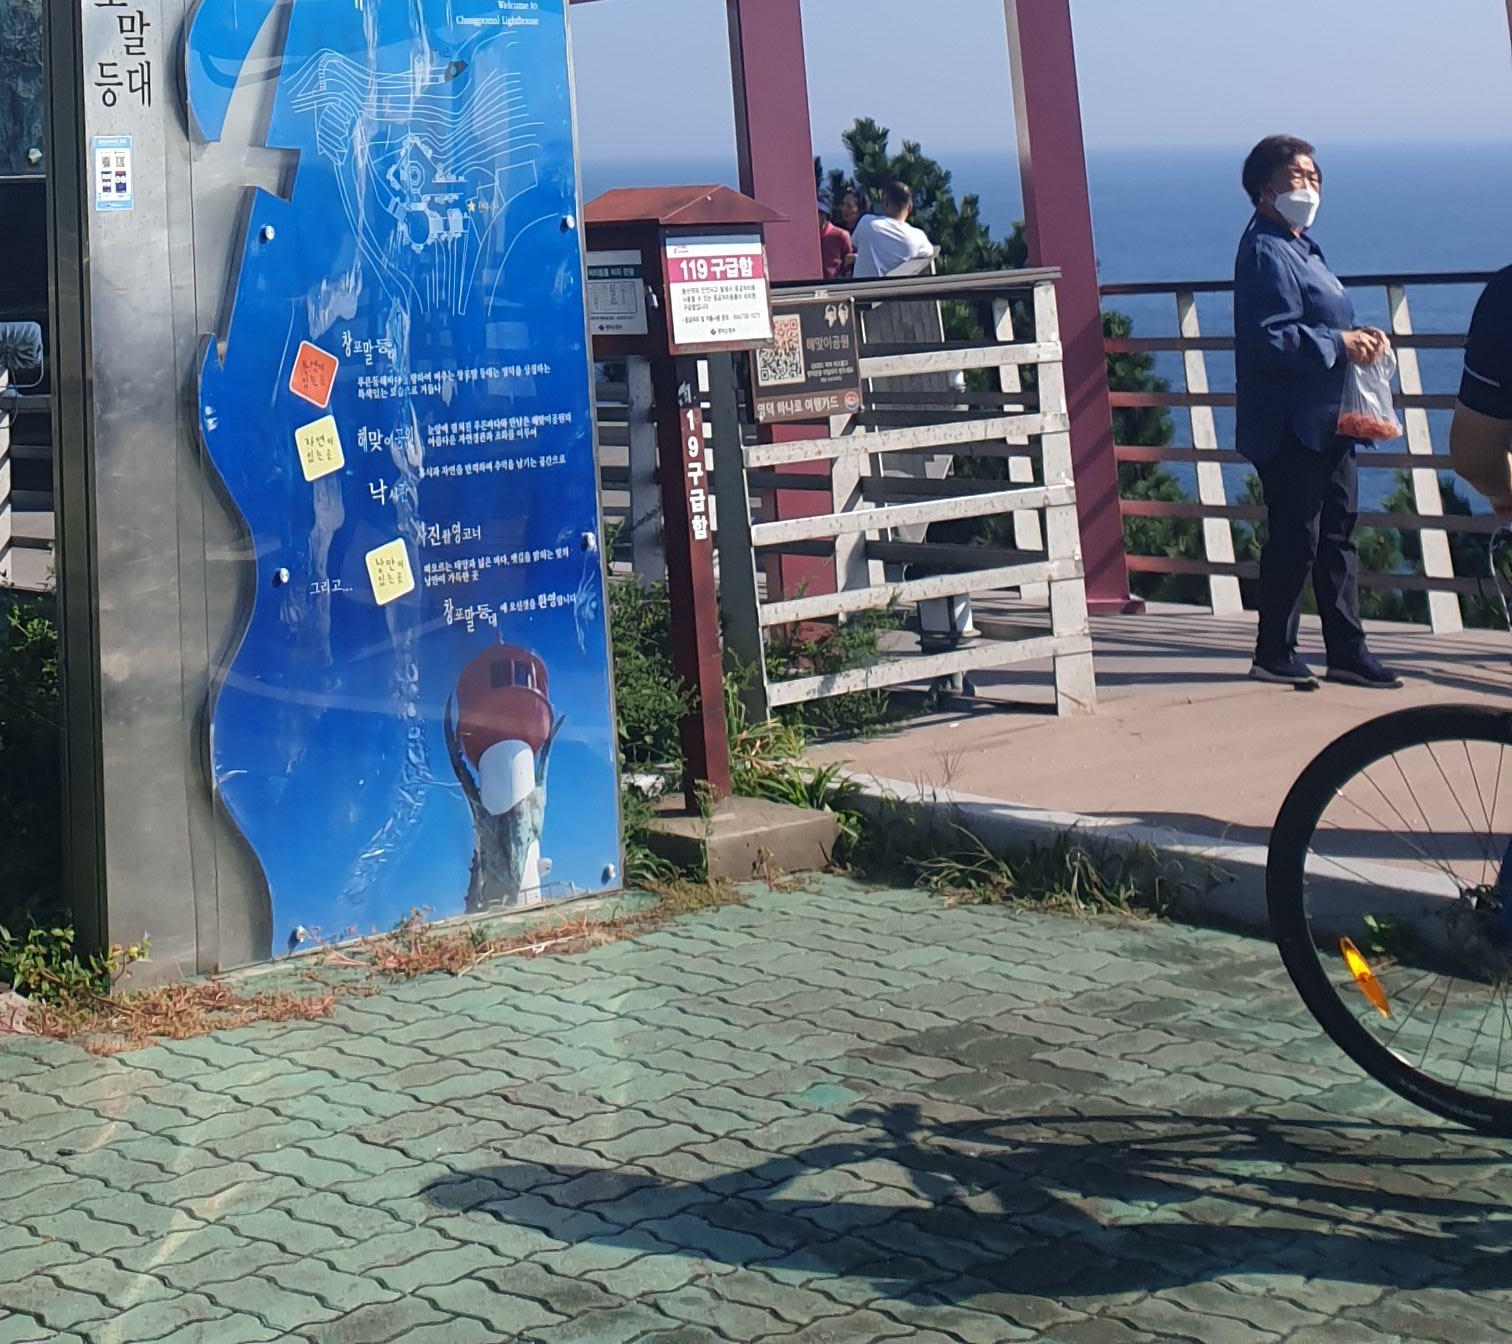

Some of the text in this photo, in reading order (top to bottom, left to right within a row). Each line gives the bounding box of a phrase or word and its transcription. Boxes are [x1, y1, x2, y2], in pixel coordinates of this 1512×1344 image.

[497, 0, 538, 10] Welcome to
[501, 15, 539, 26] Lighthouse
[680, 256, 754, 281] 119 구급함
[806, 334, 849, 352] 해맞이공원
[757, 401, 775, 421] 영덕
